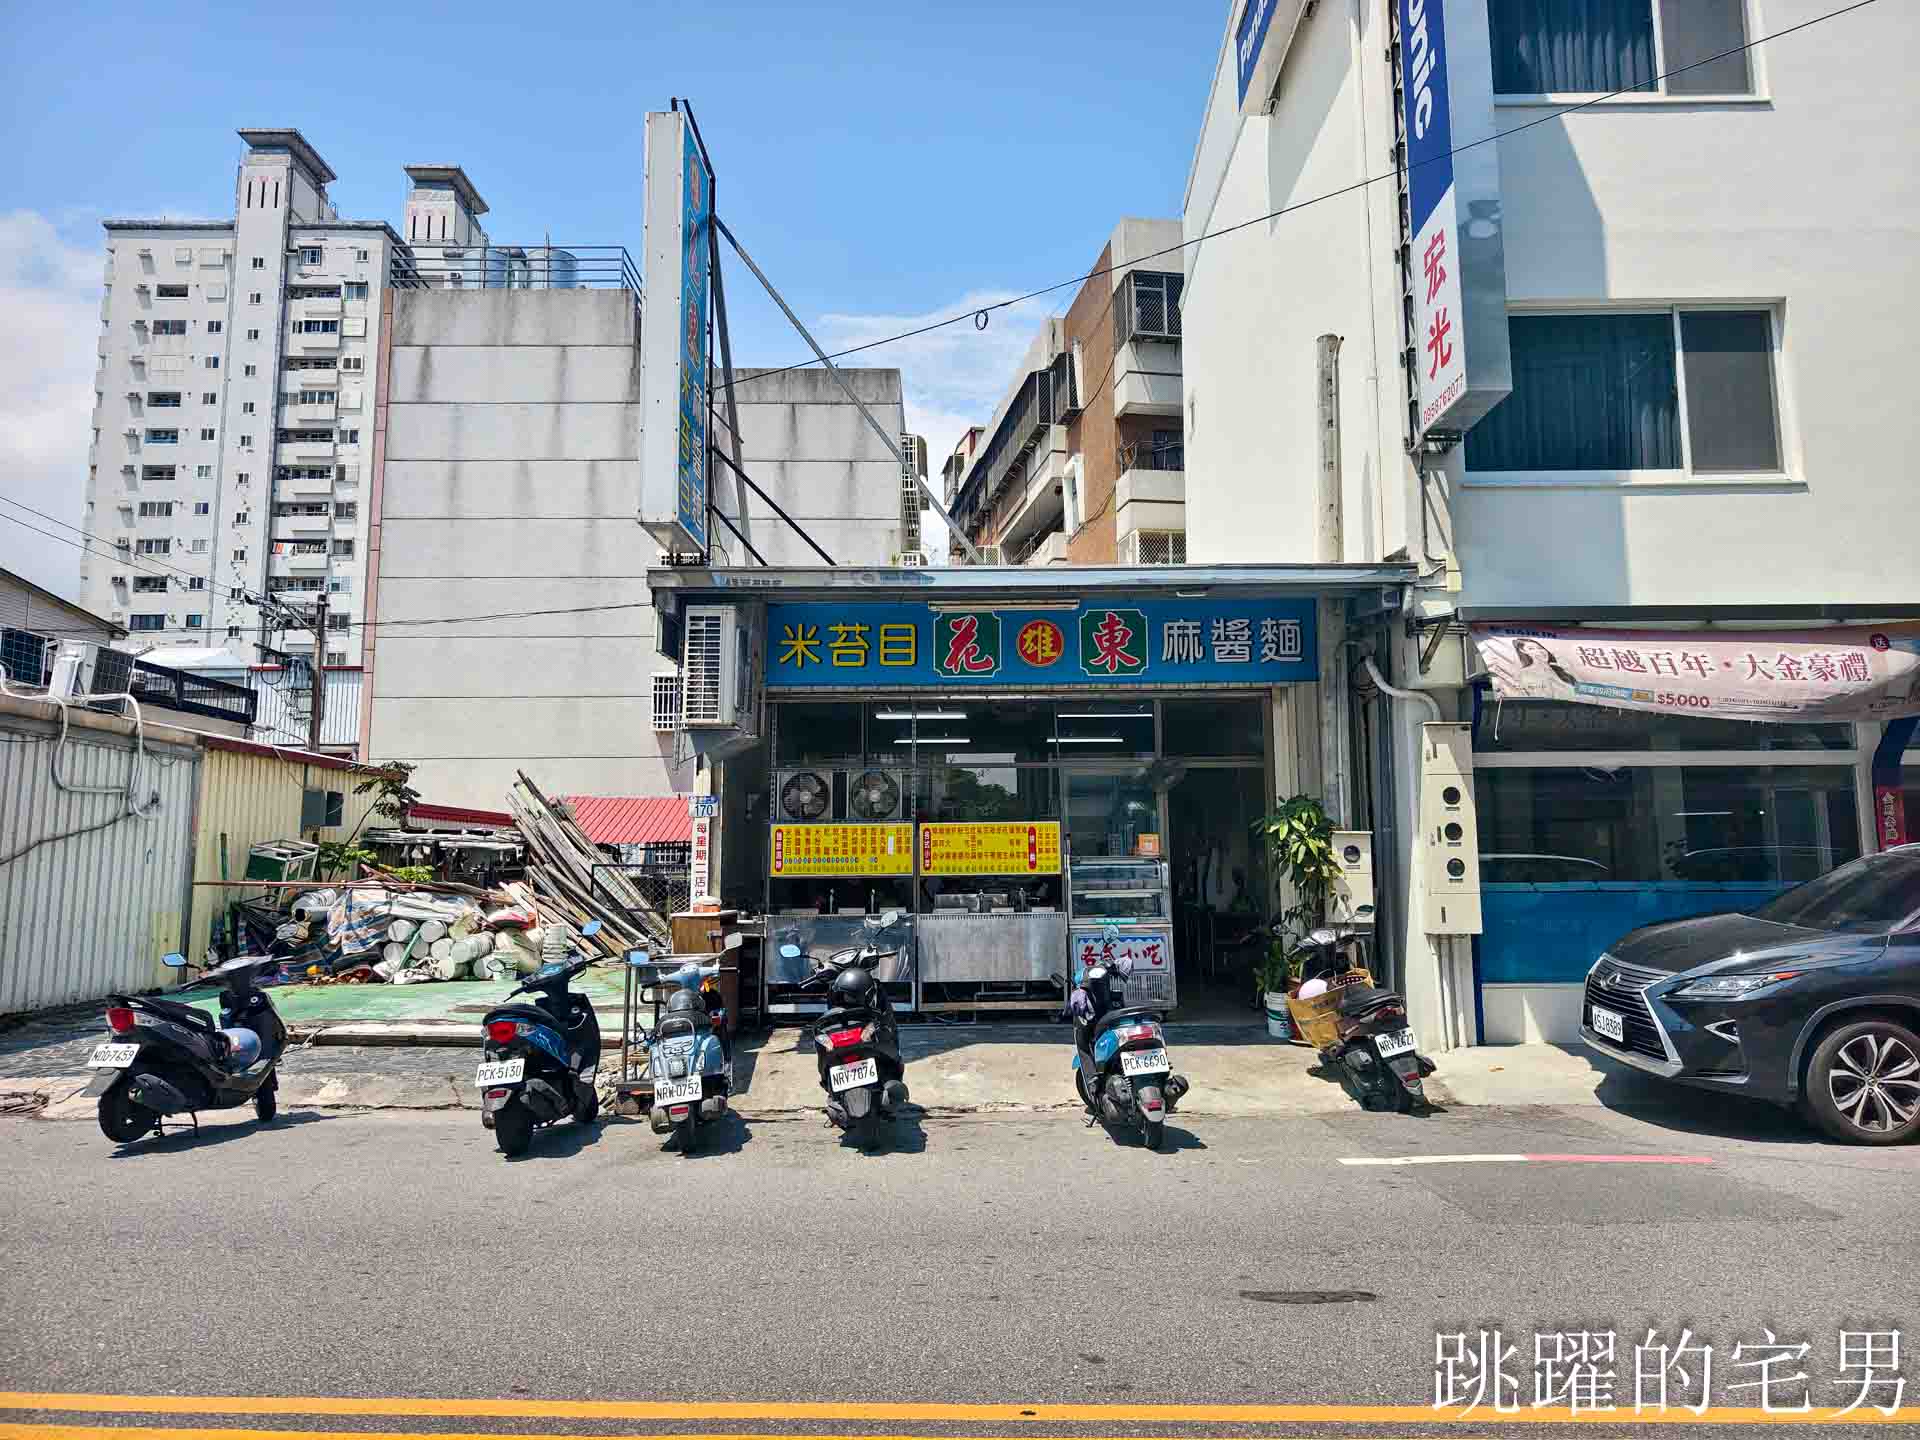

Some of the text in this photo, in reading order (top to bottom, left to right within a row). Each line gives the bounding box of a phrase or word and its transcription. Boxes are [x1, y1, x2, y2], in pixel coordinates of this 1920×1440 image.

[1424, 228, 1452, 381] 宏光
[779, 622, 917, 668] 米苔目
[1161, 617, 1304, 664] 麻醬麵
[1657, 692, 1711, 709] $5,000
[695, 804, 713, 817] 170
[478, 1065, 522, 1081] PCK-5130
